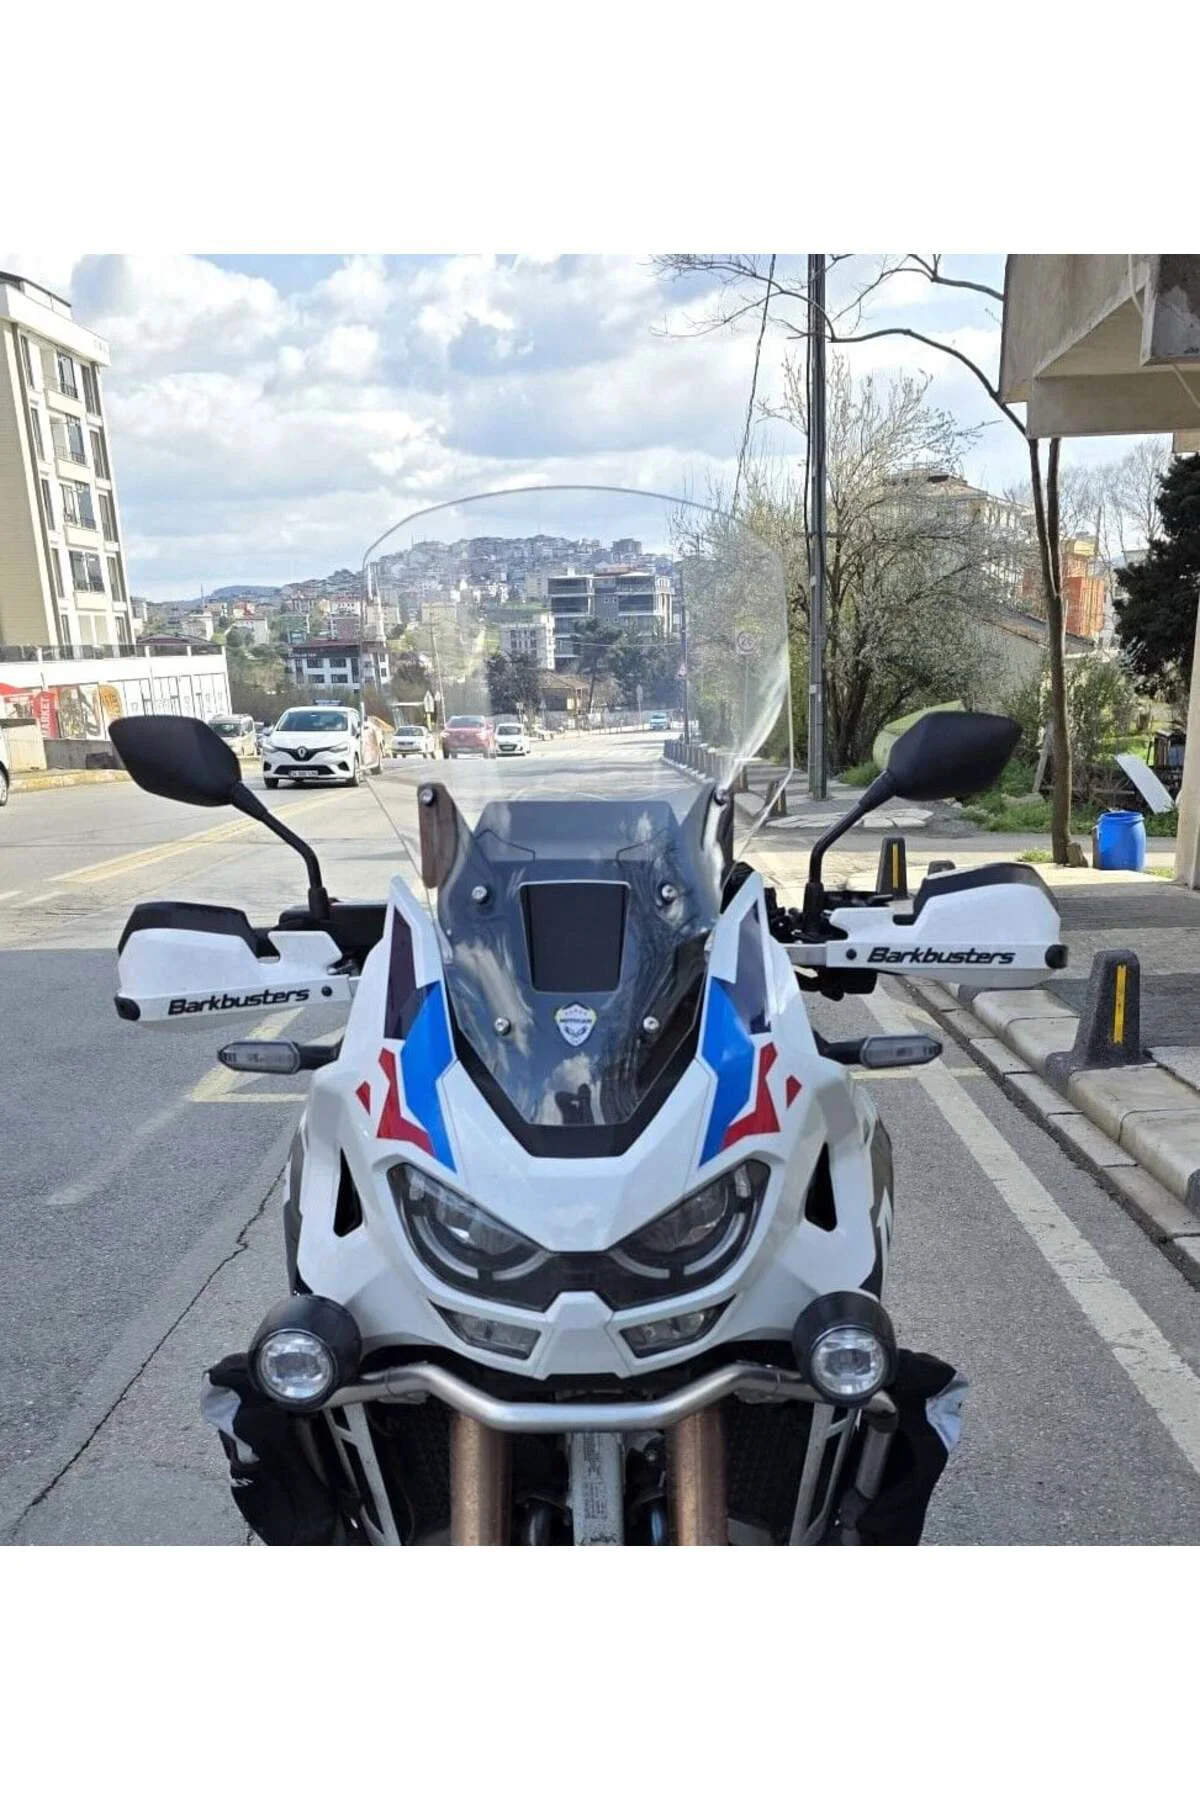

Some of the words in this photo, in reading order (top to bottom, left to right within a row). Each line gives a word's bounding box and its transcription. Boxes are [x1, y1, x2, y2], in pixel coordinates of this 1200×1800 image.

[40, 697, 50, 737] MARKET
[867, 947, 1016, 964] Barkbusters
[168, 989, 310, 1015] Barkbusters
